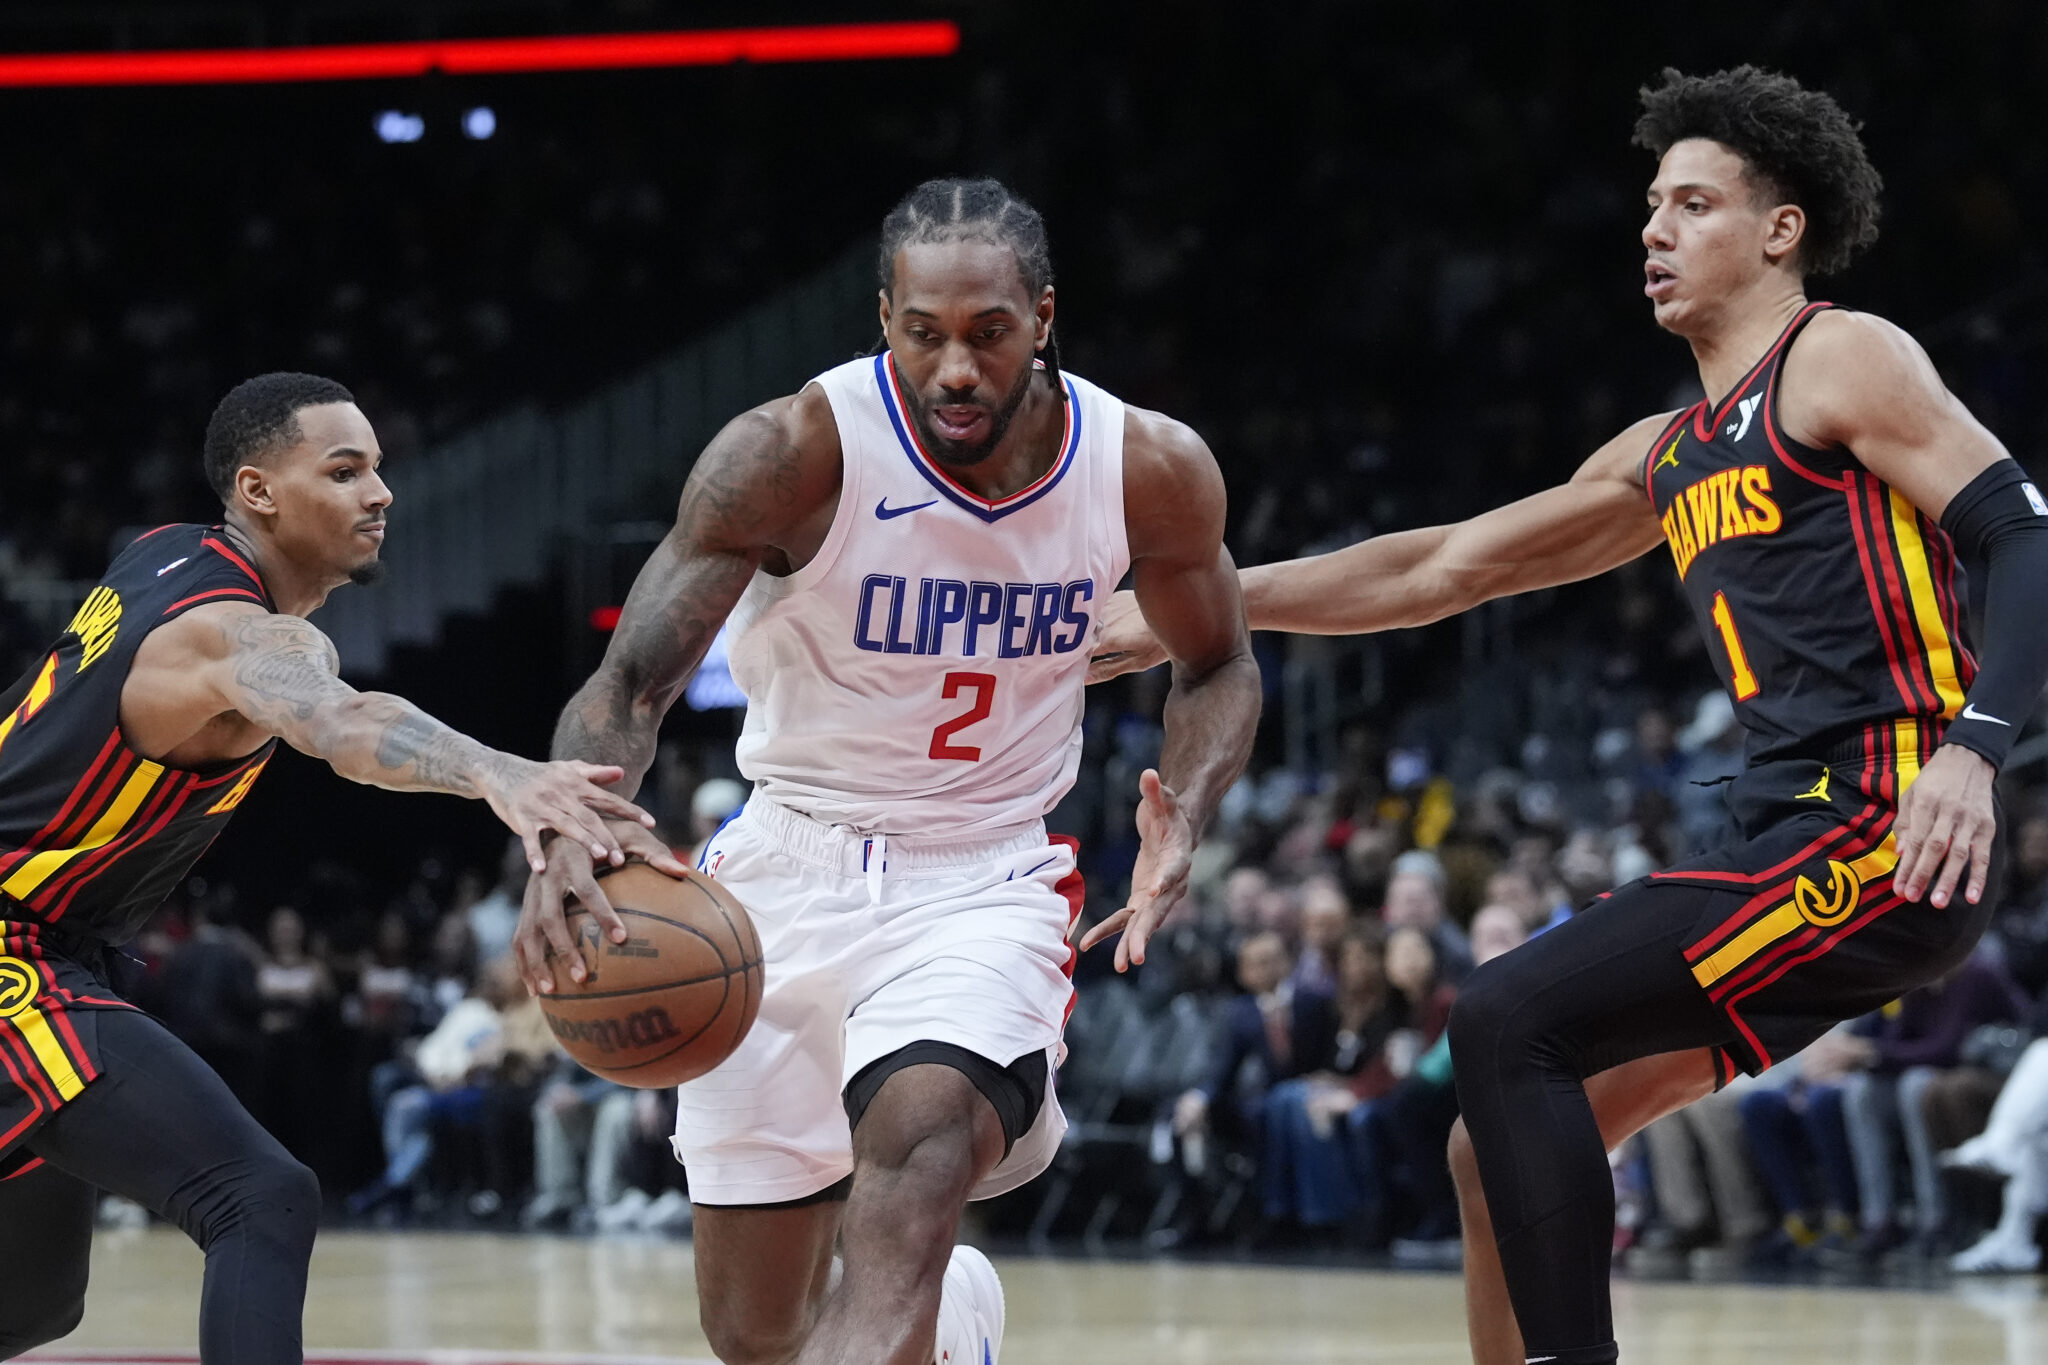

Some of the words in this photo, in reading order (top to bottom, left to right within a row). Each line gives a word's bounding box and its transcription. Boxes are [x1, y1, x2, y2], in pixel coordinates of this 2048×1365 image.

[1662, 464, 1783, 583] HAWKS
[853, 572, 1094, 659] CLIPPERS
[1710, 588, 1761, 703] 1
[928, 671, 997, 763] 2
